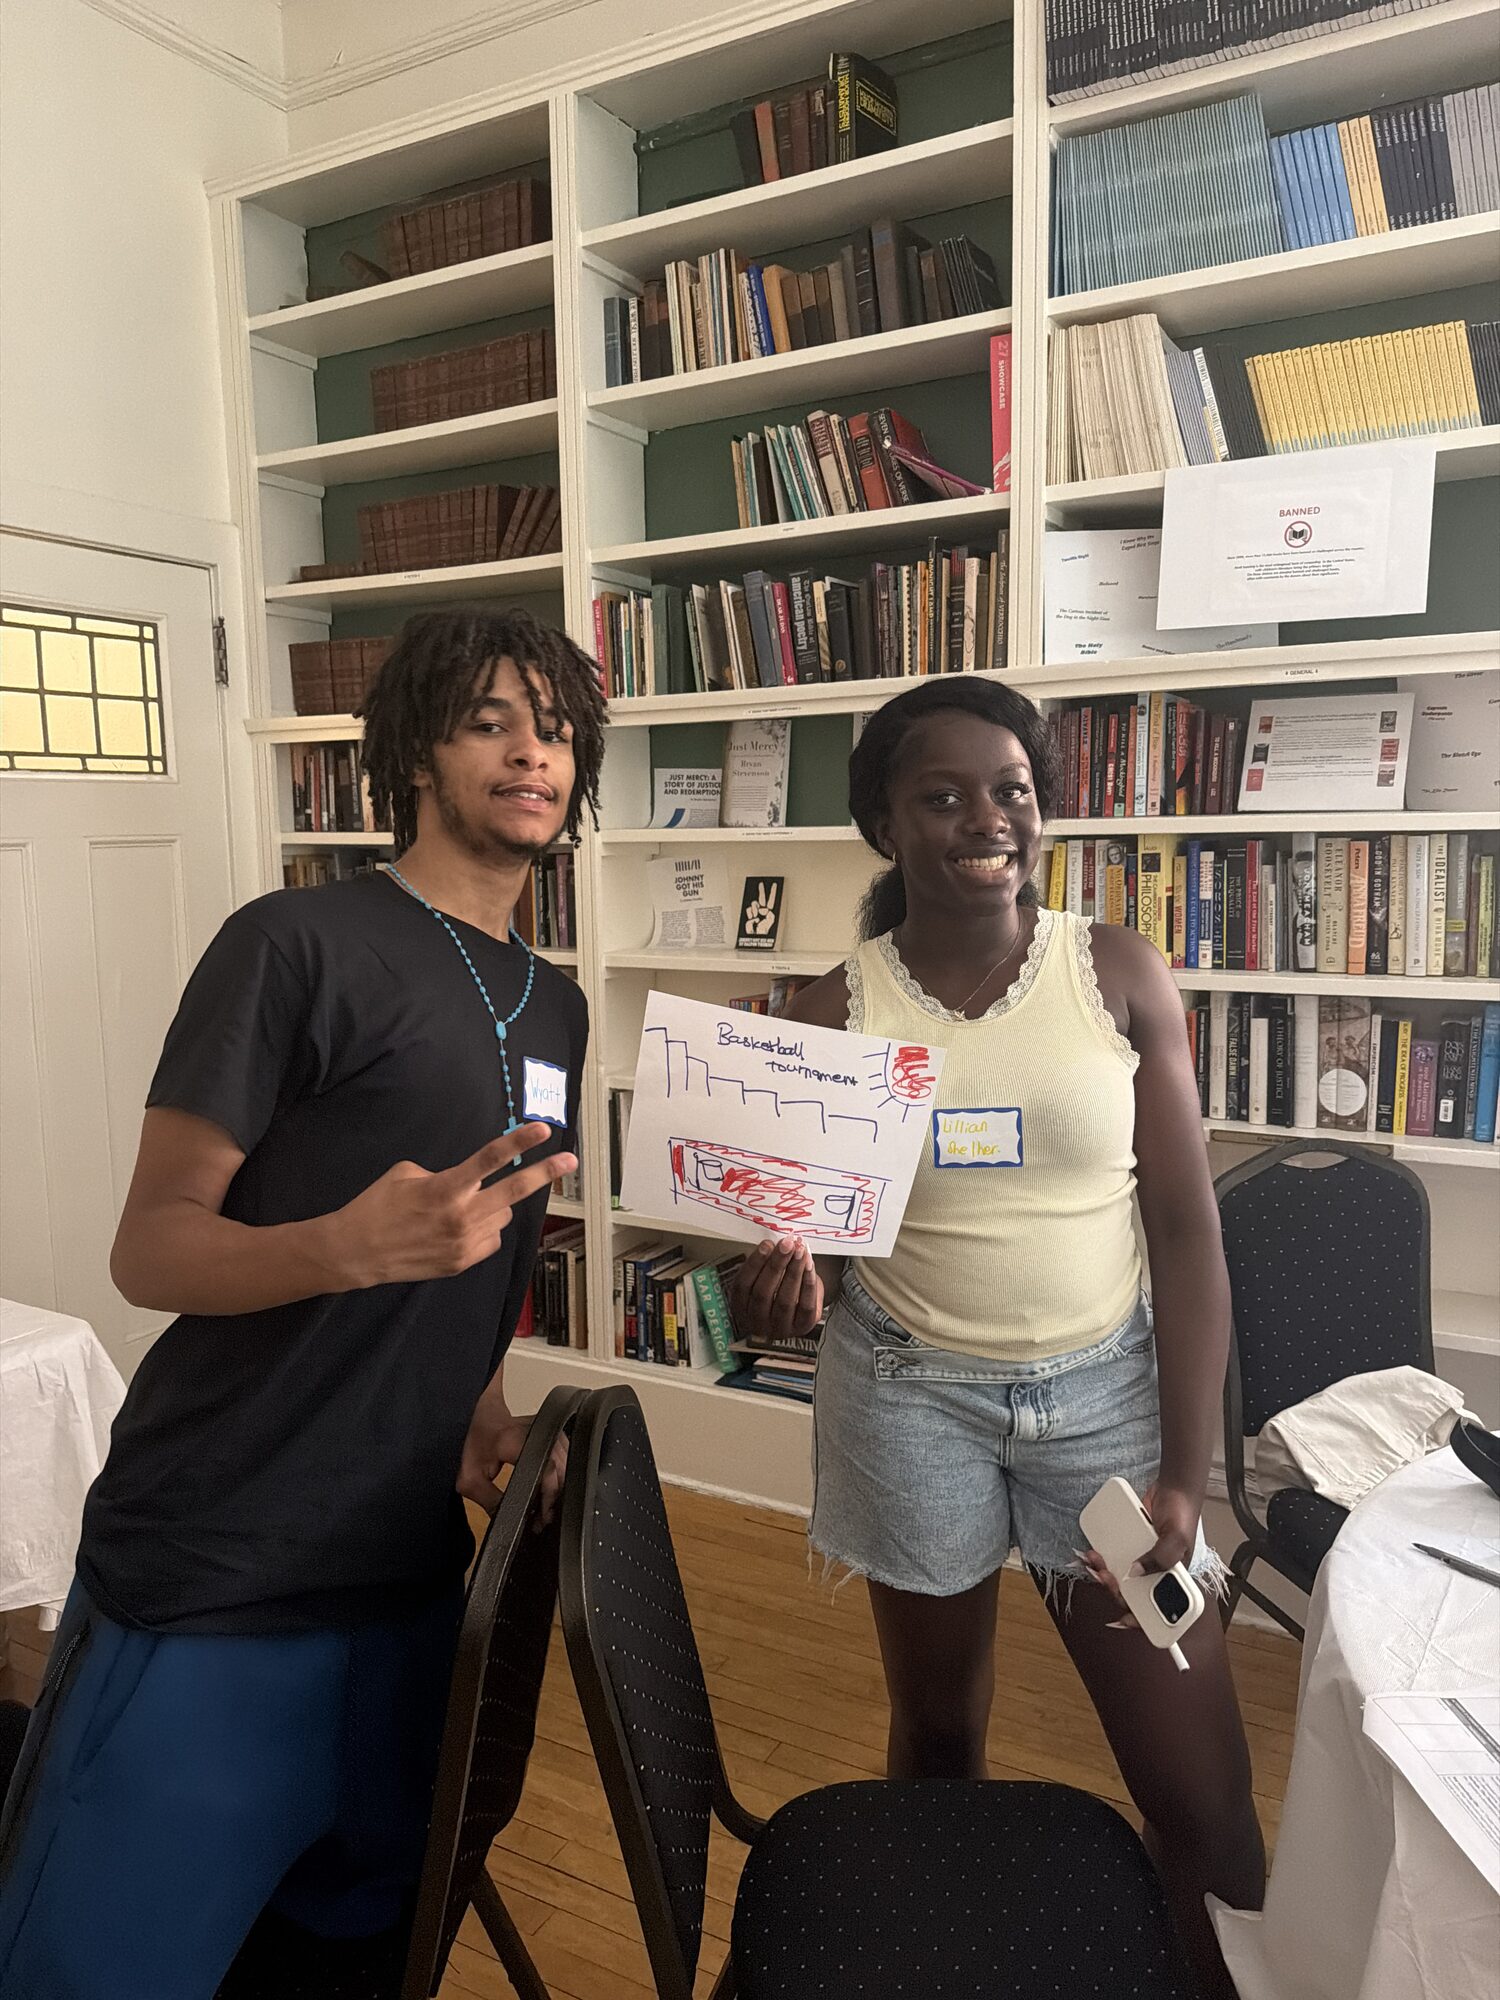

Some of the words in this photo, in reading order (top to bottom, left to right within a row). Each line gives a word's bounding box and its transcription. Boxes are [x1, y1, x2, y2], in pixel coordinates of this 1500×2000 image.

[997, 341, 1008, 357] 27
[998, 360, 1006, 410] SHOWCASE
[878, 413, 889, 435] SEVEN
[897, 481, 909, 504] VERSE
[1279, 506, 1321, 517] BANNED
[791, 576, 804, 621] american
[795, 621, 809, 651] poetry
[728, 742, 748, 751] Just
[749, 741, 779, 751] Mercy
[740, 760, 762, 768] Bryan
[1323, 842, 1333, 897] ROOSEVELT
[1334, 848, 1344, 892] ELEANOR
[1374, 850, 1382, 866] GOD
[674, 874, 704, 884] JOHNNY
[676, 882, 691, 891] GOT
[692, 881, 704, 889] HIS
[682, 889, 699, 898] GUN
[1053, 881, 1062, 905] Great
[1303, 869, 1311, 889] JON
[1350, 874, 1366, 909] ANNA
[1373, 879, 1382, 907] GOTHAM
[1433, 857, 1445, 903] IDEALIST
[1228, 876, 1236, 918] INEQUALITY
[1174, 906, 1183, 935] WOMEN
[1303, 895, 1311, 946] MEACHAM
[1350, 910, 1366, 949] FREUD
[717, 1022, 805, 1061] Basketball
[1228, 1037, 1238, 1056] FALSE
[1276, 1026, 1284, 1056] THEORY
[1228, 1057, 1238, 1076] DAWN
[1470, 1040, 1478, 1081] ENLIGHTENED
[530, 1076, 561, 1105] Wyatt
[1275, 1070, 1284, 1099] JUSTICE
[1398, 1072, 1407, 1099] PROGRESS
[942, 1117, 988, 1134] Lillian
[696, 1274, 712, 1301] BAR
[706, 1309, 729, 1363] DESIGN
